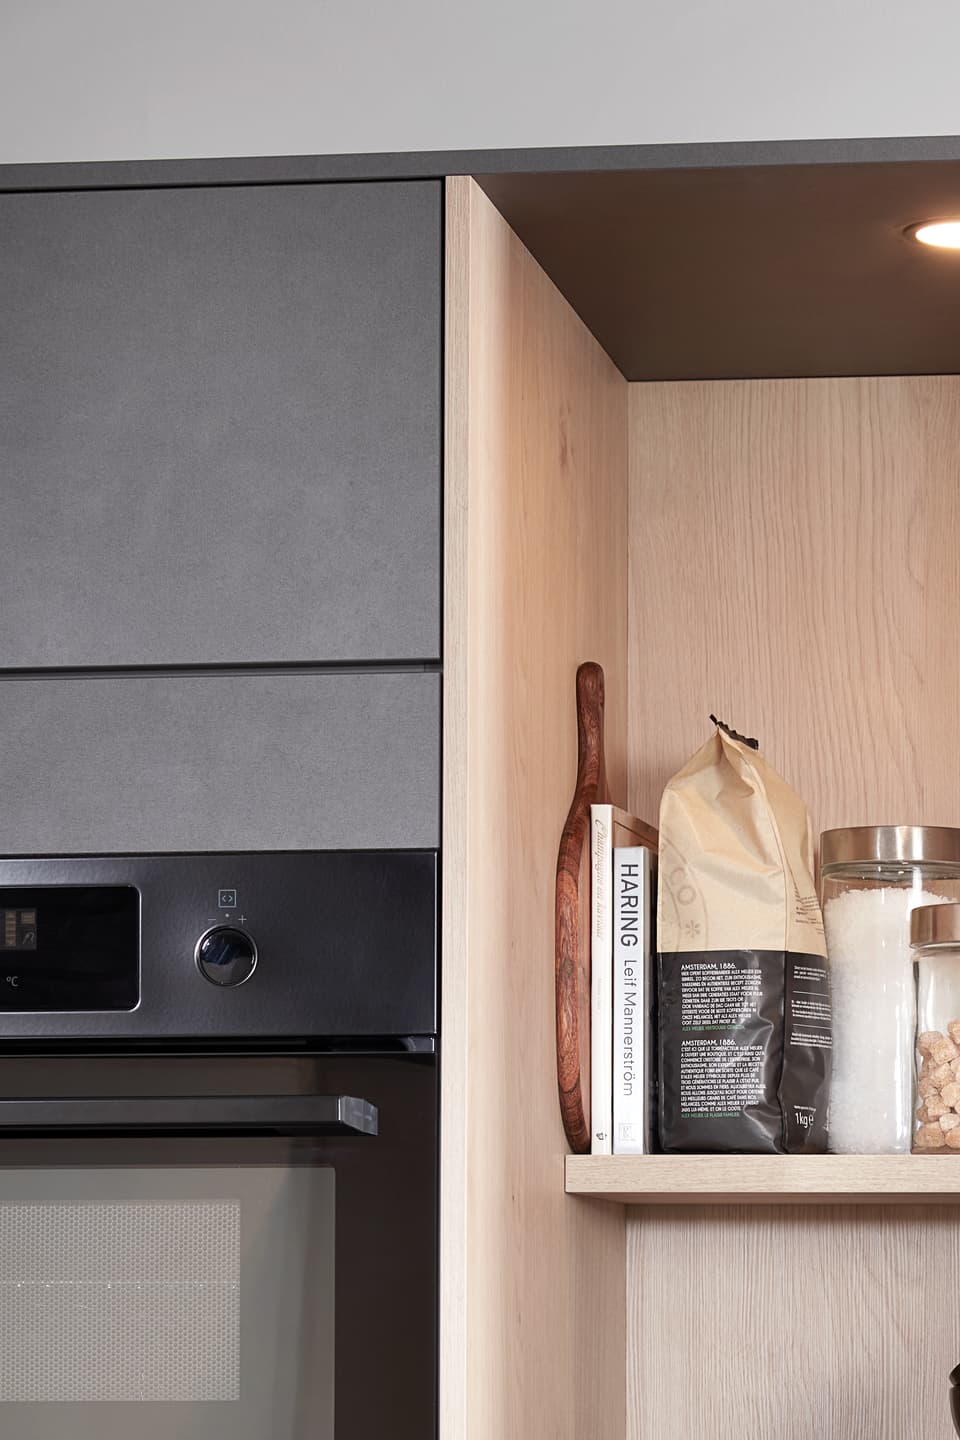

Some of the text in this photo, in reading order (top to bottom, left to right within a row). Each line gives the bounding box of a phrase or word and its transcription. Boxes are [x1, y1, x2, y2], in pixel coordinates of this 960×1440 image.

[620, 863, 639, 1097] HARING Leif Mannerström
